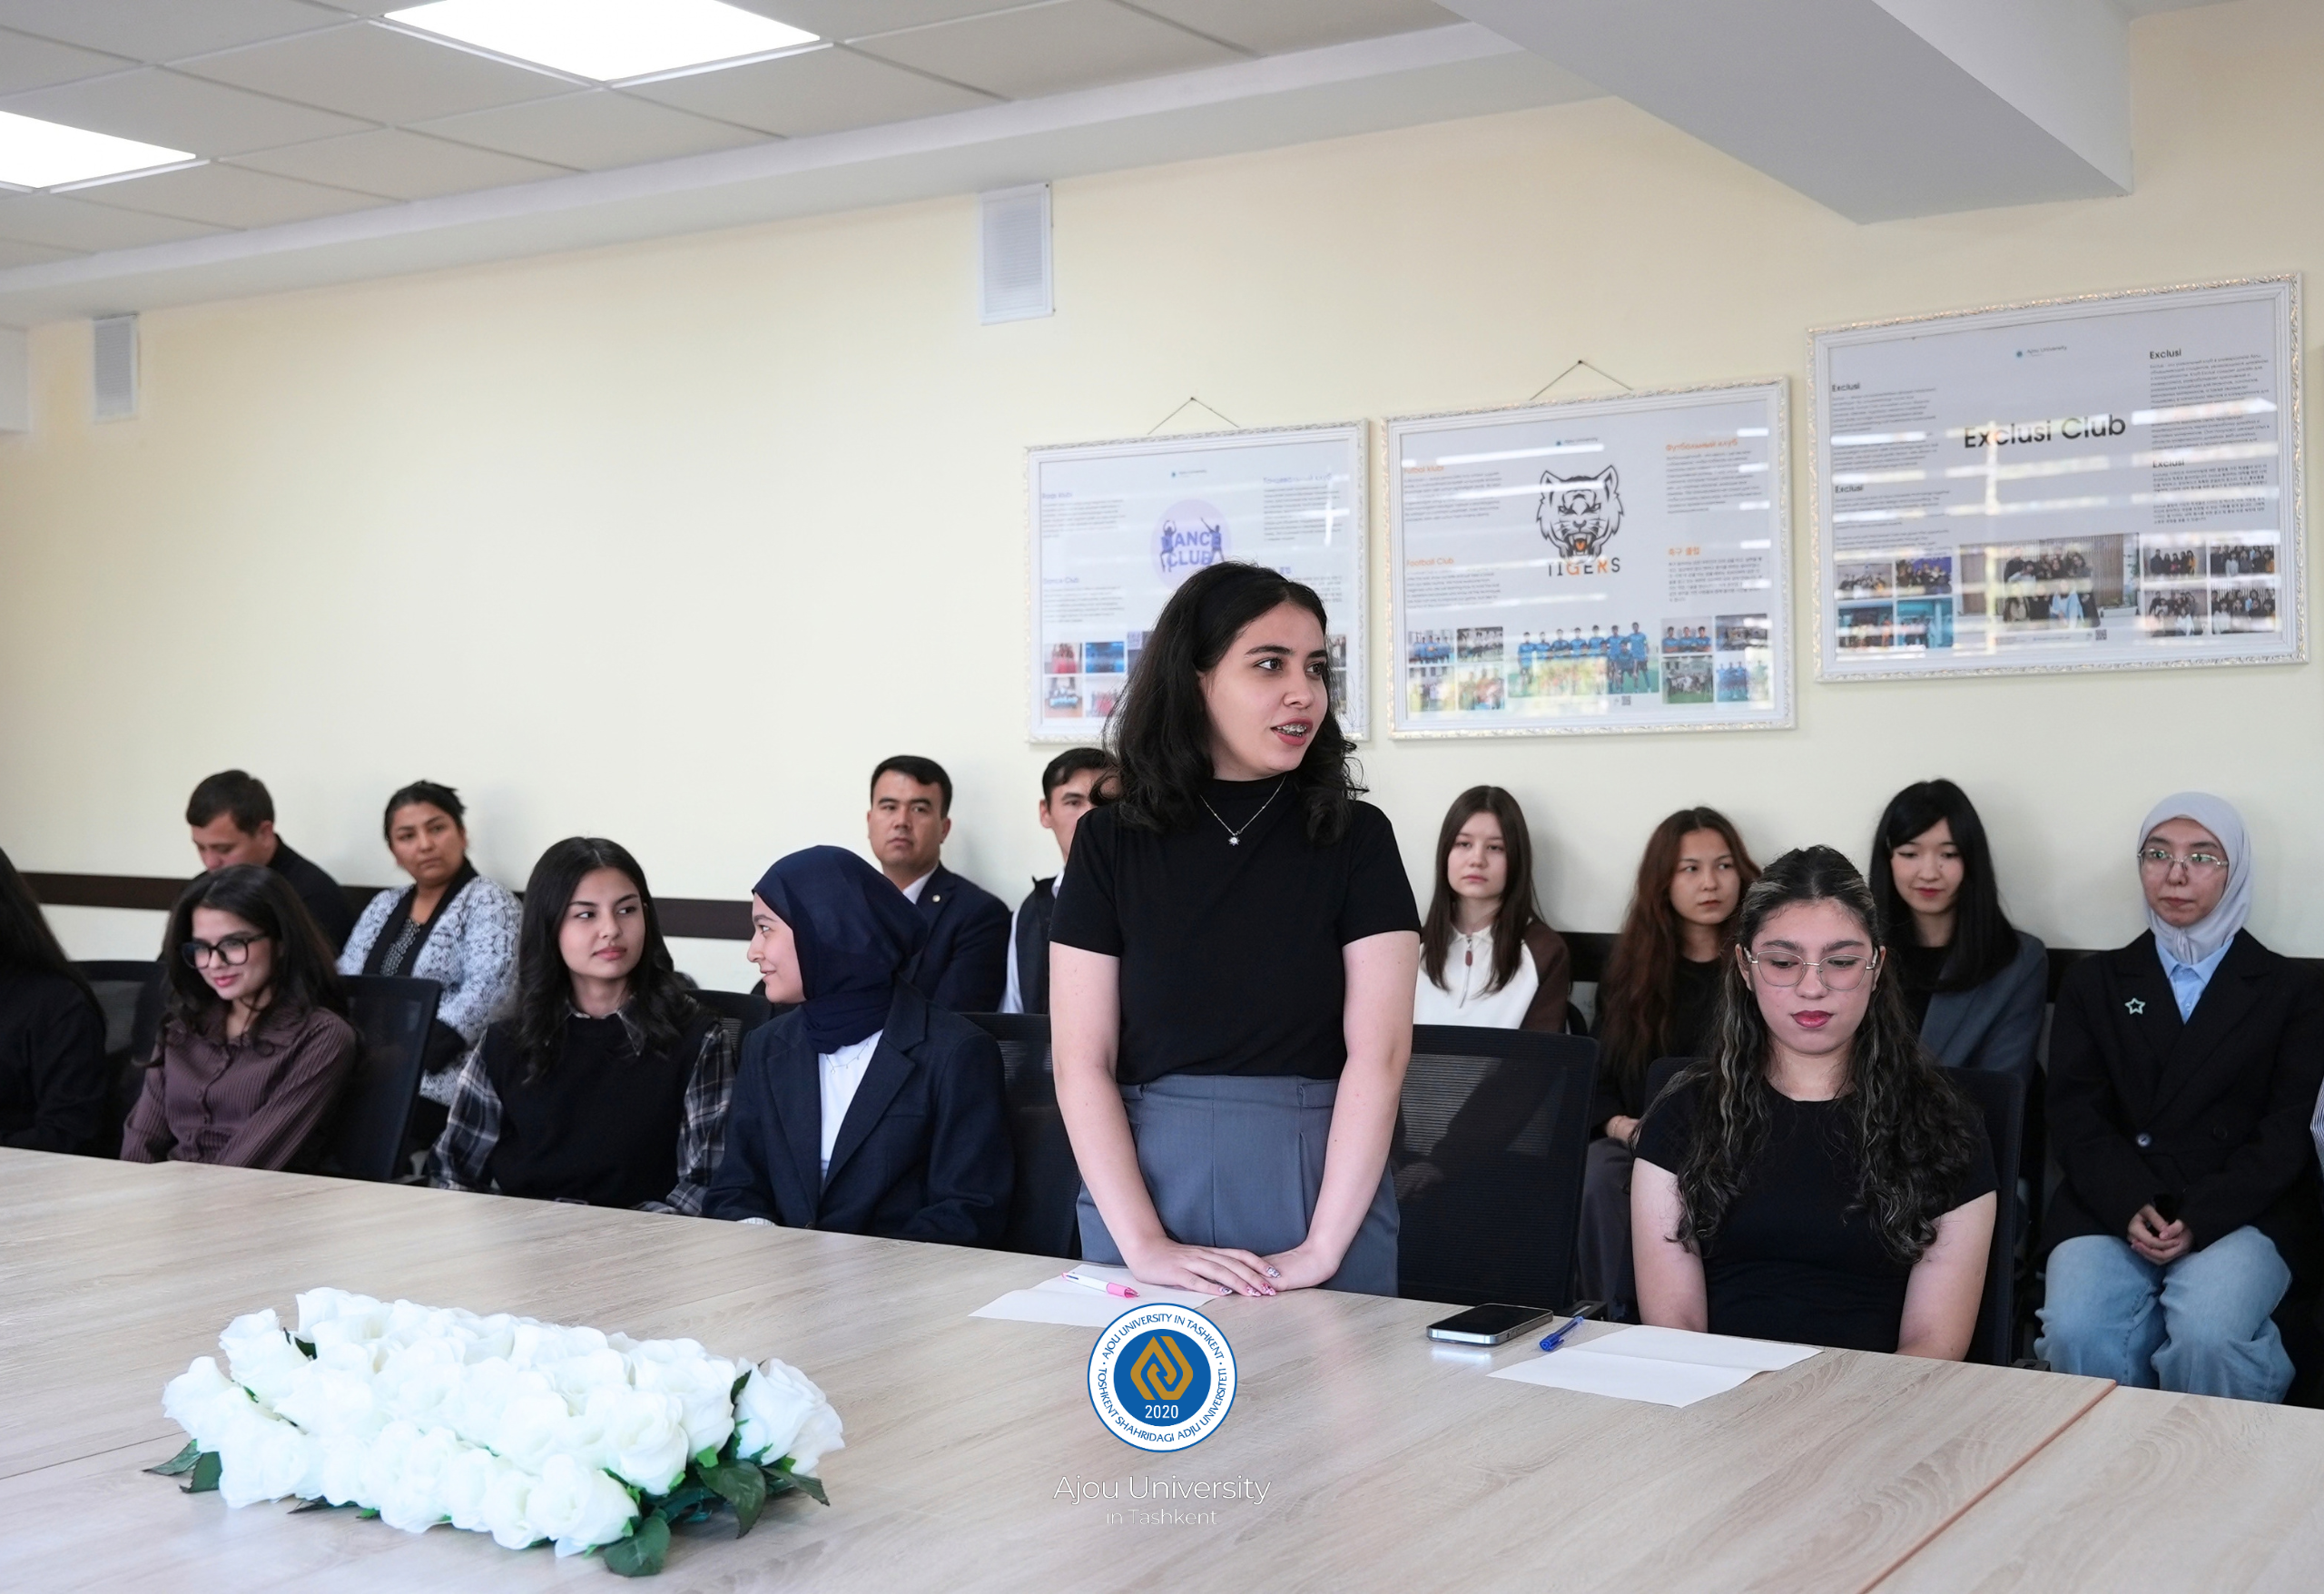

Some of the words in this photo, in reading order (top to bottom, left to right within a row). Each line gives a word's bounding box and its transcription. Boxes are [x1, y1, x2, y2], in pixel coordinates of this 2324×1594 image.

[2149, 349, 2181, 359] Exclusi
[1831, 383, 1860, 392] Exclusi
[1965, 420, 2052, 448] Exclusi
[2061, 414, 2126, 439] Club
[2152, 458, 2185, 468] Exclusi
[1835, 485, 1864, 494] Exclusi
[1167, 550, 1214, 567] CLUB
